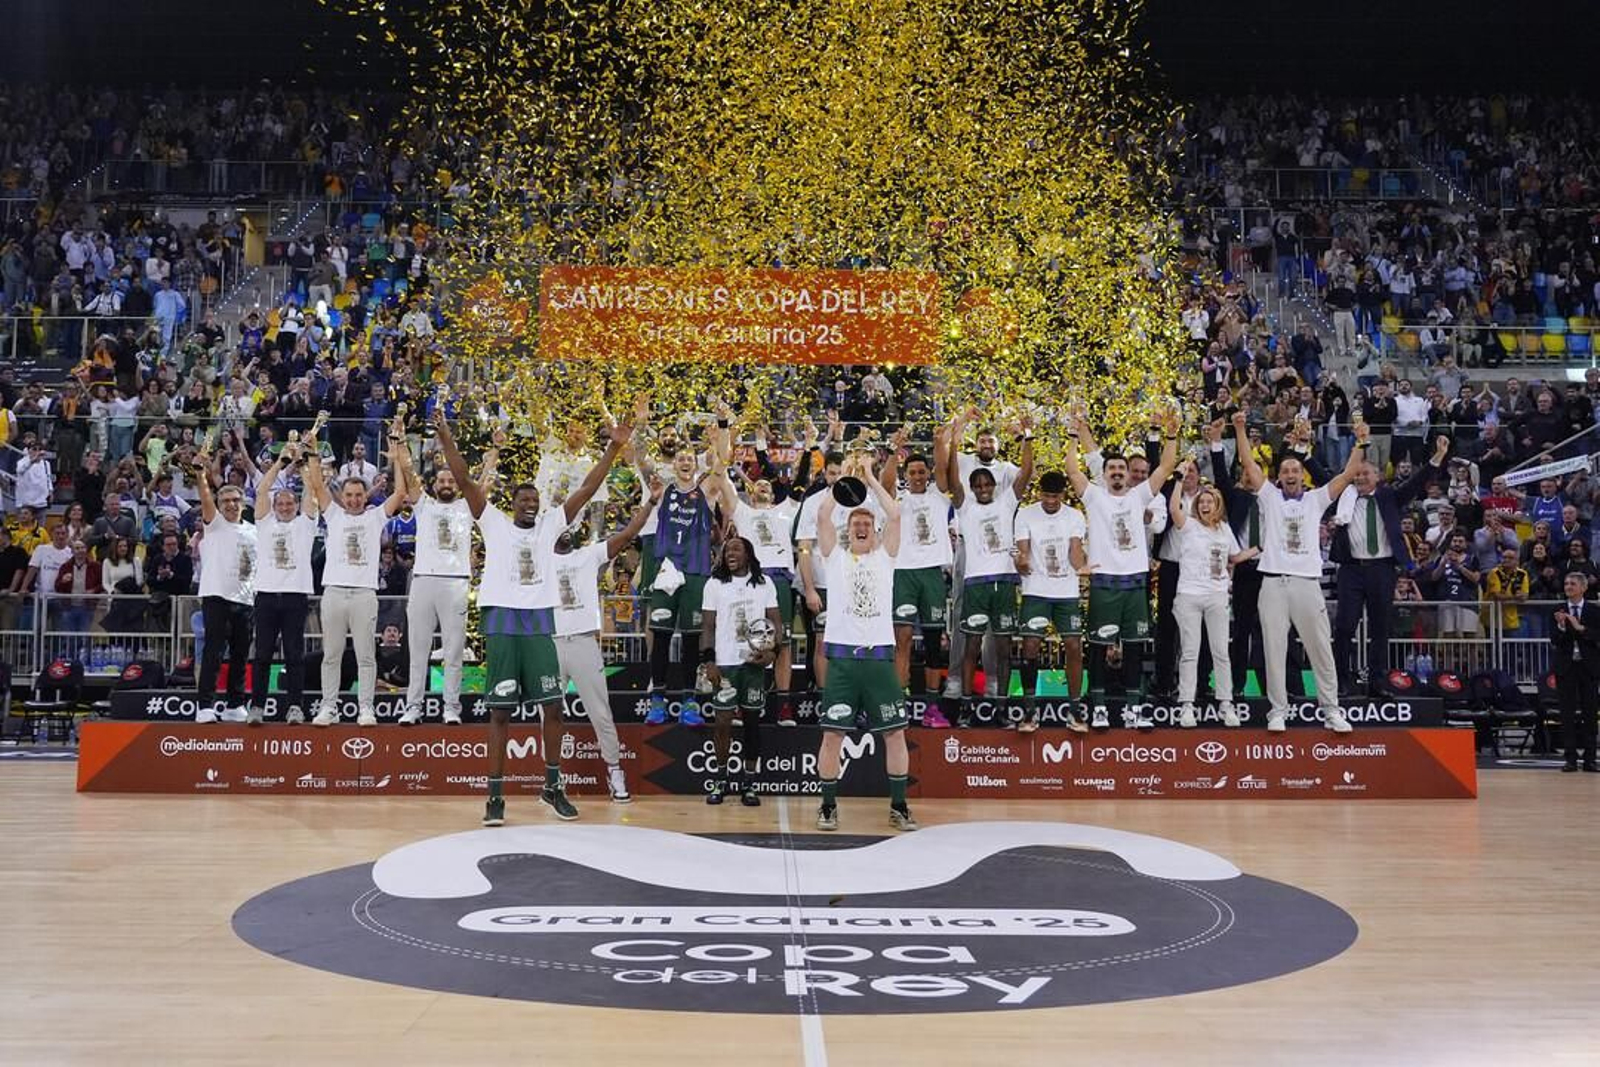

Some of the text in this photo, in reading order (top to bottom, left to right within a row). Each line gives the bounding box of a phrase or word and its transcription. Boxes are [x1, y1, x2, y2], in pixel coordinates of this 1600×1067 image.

[738, 288, 815, 313] COPA
[821, 289, 869, 314] DEL
[882, 290, 931, 315] REY
[676, 530, 683, 545] 1
[162, 737, 244, 754] mediolanum
[263, 739, 312, 755] IONOS
[401, 738, 488, 758] endesa
[961, 746, 1010, 755] Cabildo de
[1246, 744, 1294, 760] IONOS
[1313, 744, 1386, 758] mediolanum
[961, 754, 1020, 764] Gran Canaria
[1091, 743, 1177, 763] endesa
[766, 756, 796, 772] del
[296, 780, 326, 788] LOTUS
[335, 780, 375, 788] EXPRESS
[400, 771, 429, 783] renfe
[966, 775, 1008, 787] Wilson
[1073, 778, 1115, 786] KUMHO
[1129, 774, 1162, 787] renfe
[1174, 781, 1213, 789] EXPRESS
[1237, 781, 1267, 789] LOTUS
[489, 914, 673, 926] Gran
[694, 914, 997, 928] Canaria
[591, 939, 977, 966] Copa
[612, 966, 1053, 1005] del Rey
